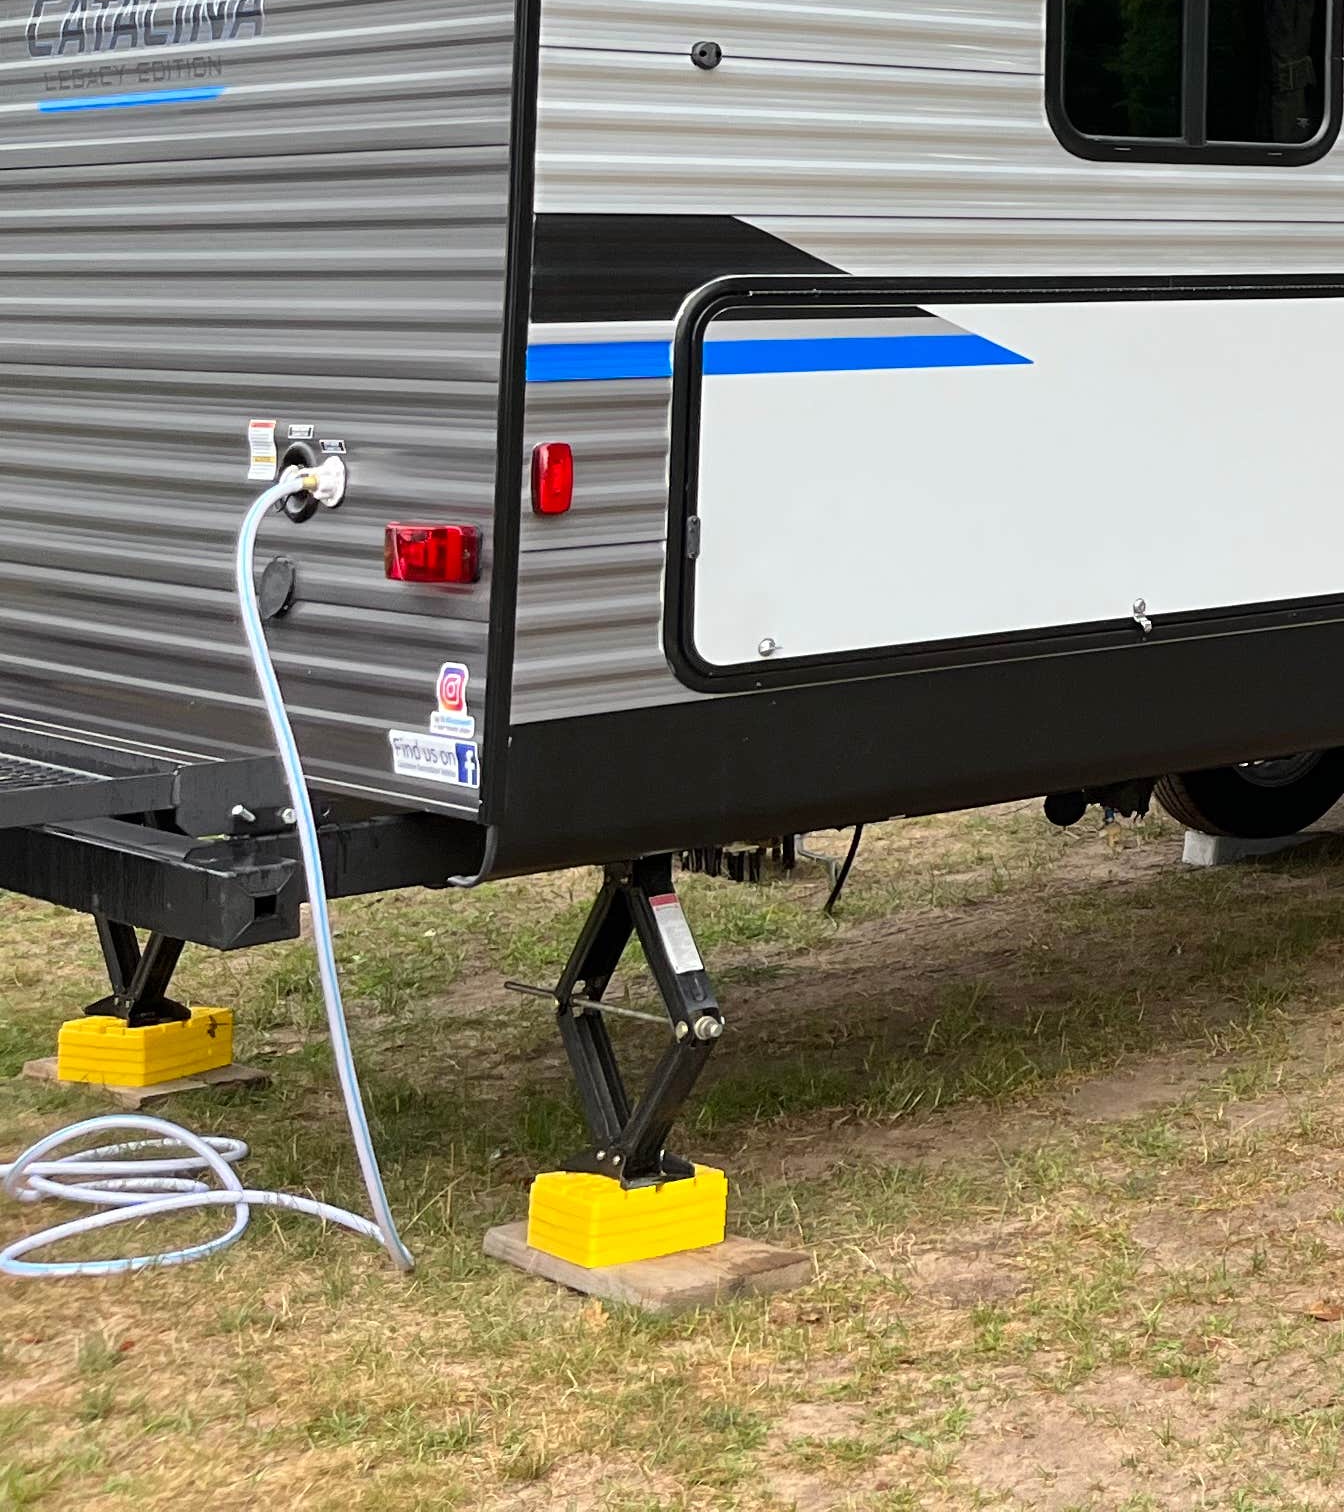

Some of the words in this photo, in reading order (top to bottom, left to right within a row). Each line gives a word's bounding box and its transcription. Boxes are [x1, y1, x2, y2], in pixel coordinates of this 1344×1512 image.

[44, 65, 128, 91] LEGACY
[136, 55, 222, 84] EDITION
[392, 737, 420, 761] Find
[422, 747, 438, 764] us
[440, 749, 456, 767] on
